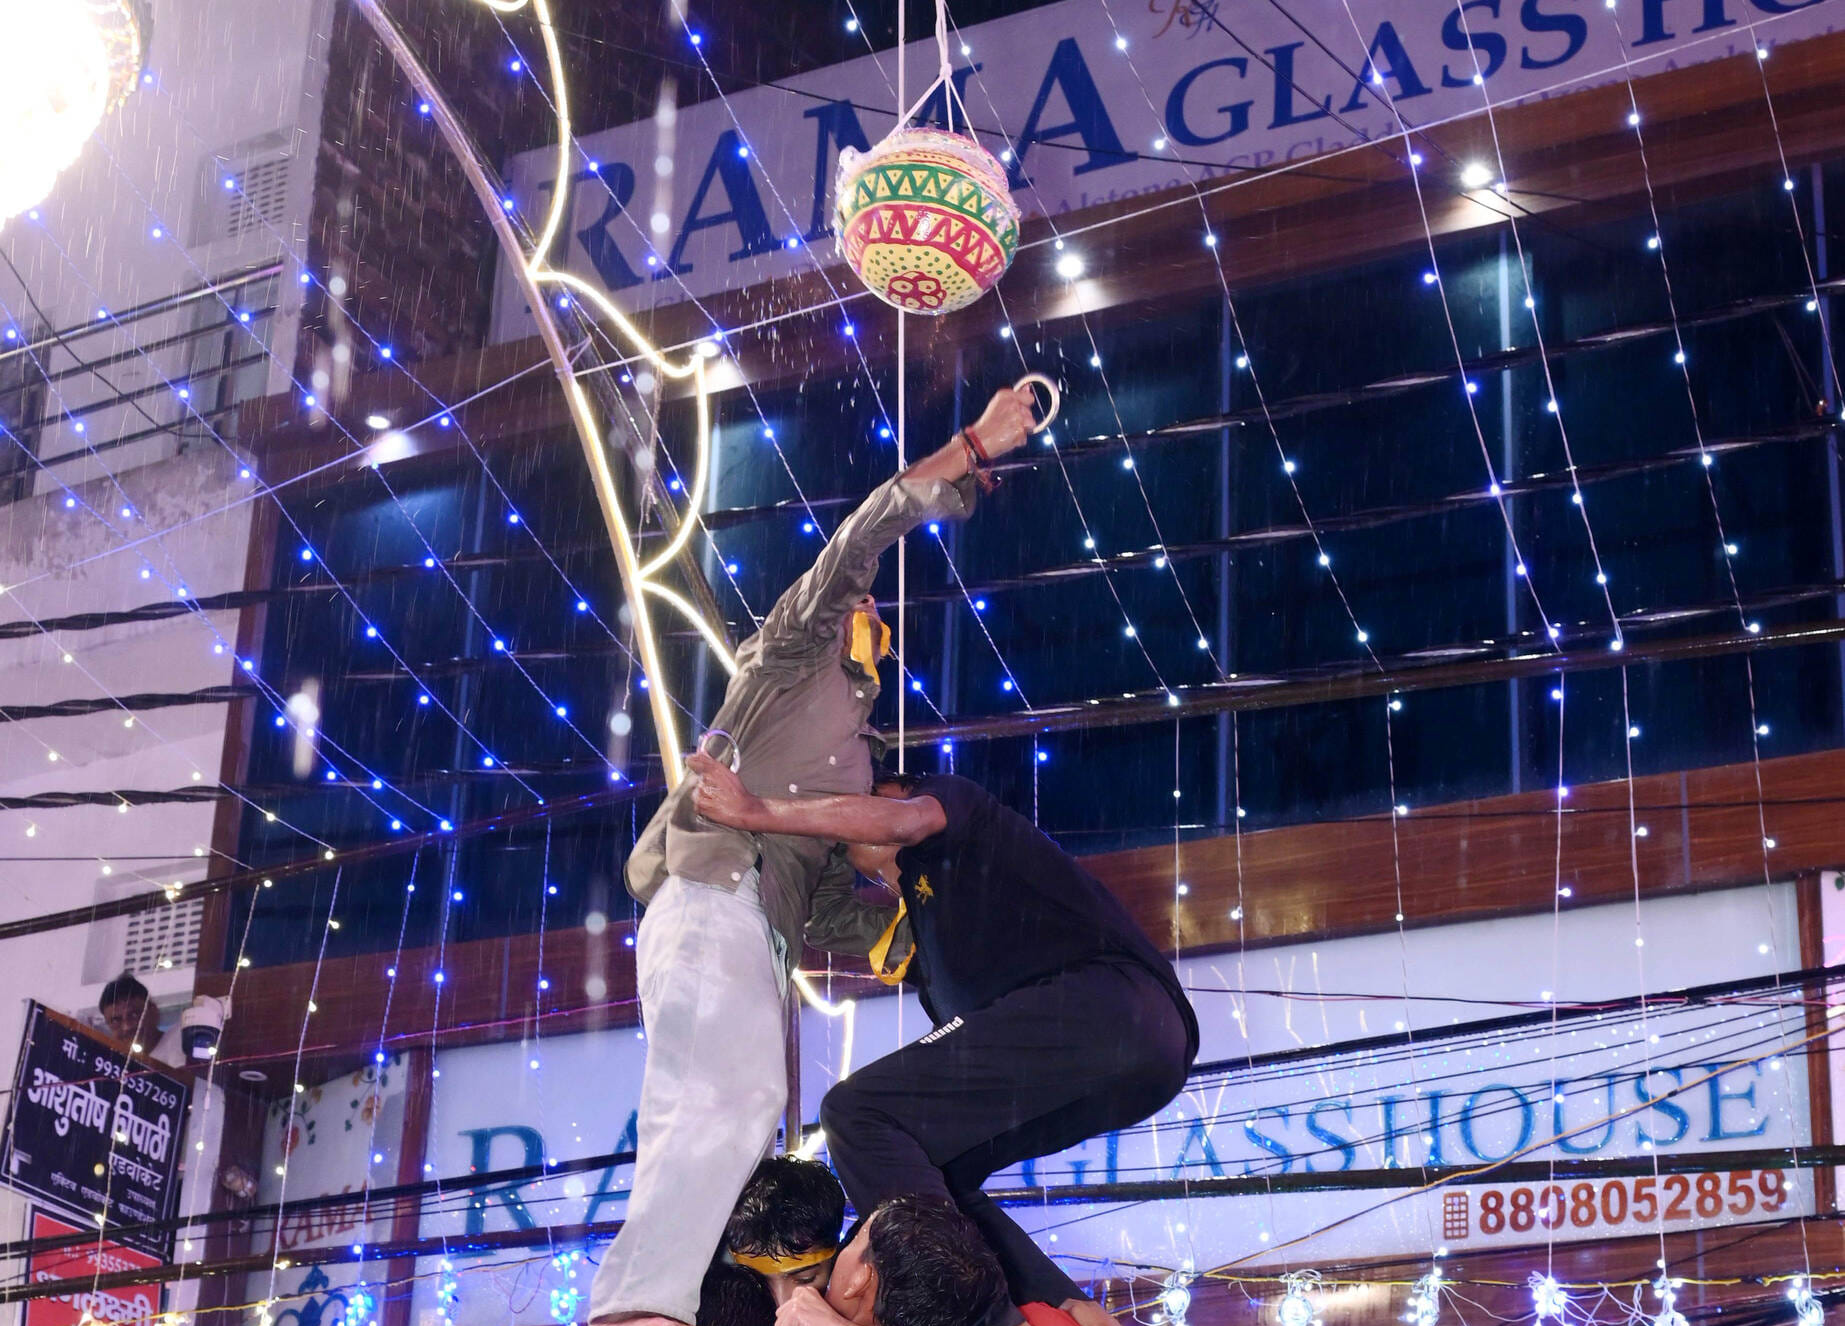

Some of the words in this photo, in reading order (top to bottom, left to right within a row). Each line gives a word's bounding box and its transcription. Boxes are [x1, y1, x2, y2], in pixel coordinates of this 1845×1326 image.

[1164, 0, 1588, 147] GLASS
[27, 1067, 110, 1136] आशुतोष
[1479, 1169, 1788, 1235] 8808052859
